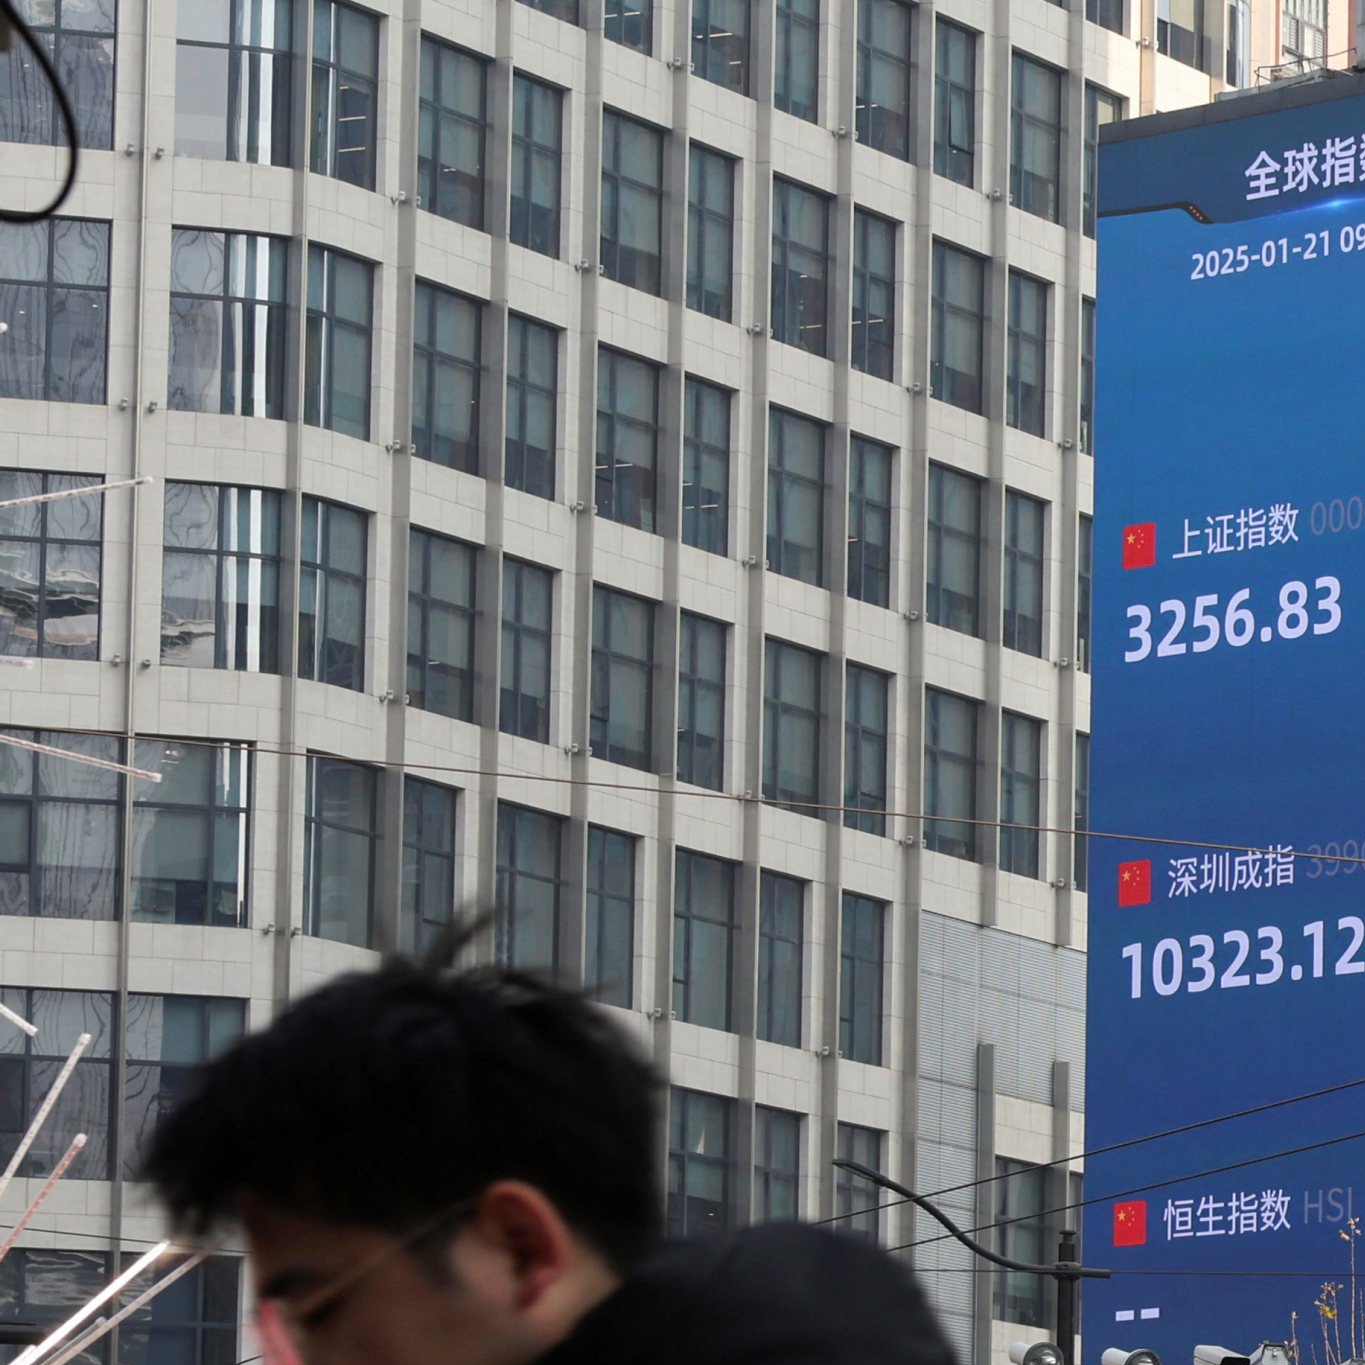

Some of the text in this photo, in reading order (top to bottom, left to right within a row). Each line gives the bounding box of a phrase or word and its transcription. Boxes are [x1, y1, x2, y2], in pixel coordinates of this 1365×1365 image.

[1190, 230, 1331, 280] 2025-01-21
[1172, 502, 1300, 560] 上证指数
[1123, 575, 1342, 663] 3256.83
[1167, 844, 1295, 899] 深圳成指
[1163, 1189, 1292, 1241] 恒生指数
